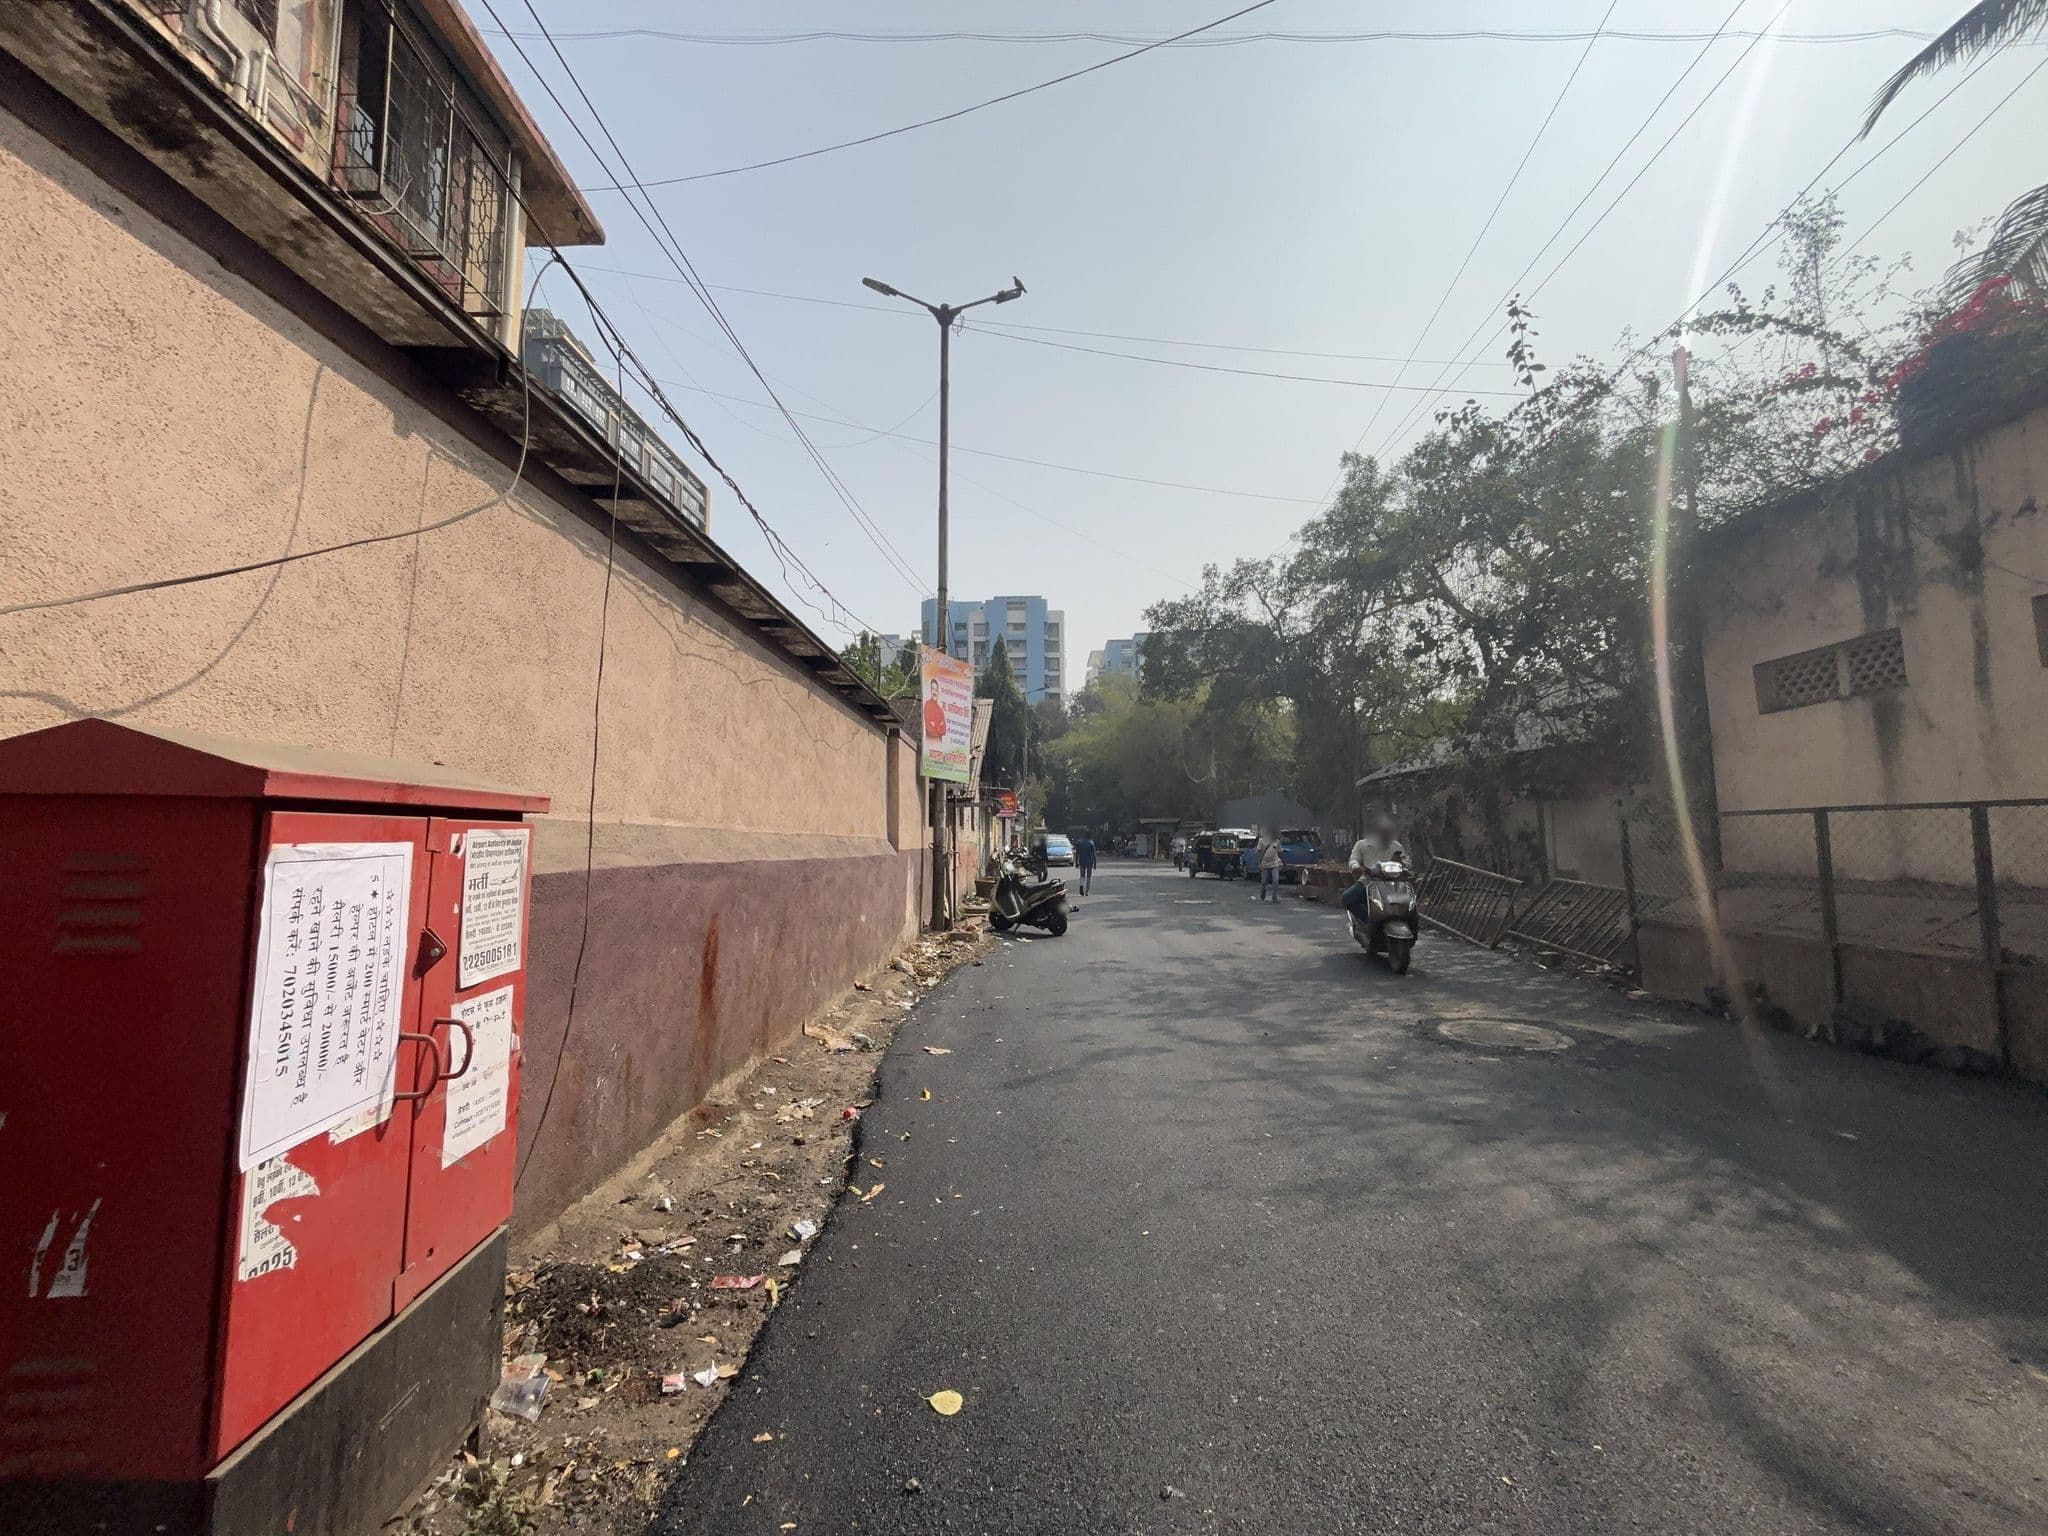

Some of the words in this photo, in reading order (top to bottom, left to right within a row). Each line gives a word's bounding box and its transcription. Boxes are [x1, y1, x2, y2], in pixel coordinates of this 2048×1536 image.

[371, 875, 379, 883] 5
[468, 872, 489, 891] भर्ती
[289, 886, 306, 924] संपर्क
[308, 885, 326, 917] रहने
[330, 899, 346, 939] सैलरी
[349, 903, 364, 940] हेल्पर
[367, 906, 381, 942] होटल
[307, 921, 323, 953] खाने
[347, 944, 361, 962] की
[306, 956, 321, 976] की
[325, 945, 340, 1001] 15000/-
[363, 962, 375, 988] 200
[300, 980, 319, 1028] सुविधा
[323, 1003, 337, 1016] से
[360, 990, 371, 1025] स्मार्ट
[275, 965, 297, 1077] 7020345015
[317, 1021, 333, 1080] 20000/-
[356, 1027, 370, 1056] वेटर
[295, 1032, 311, 1088] उपलब्ध
[333, 1053, 350, 1068] है
[352, 1061, 366, 1086] और
[289, 1092, 309, 1108] है
